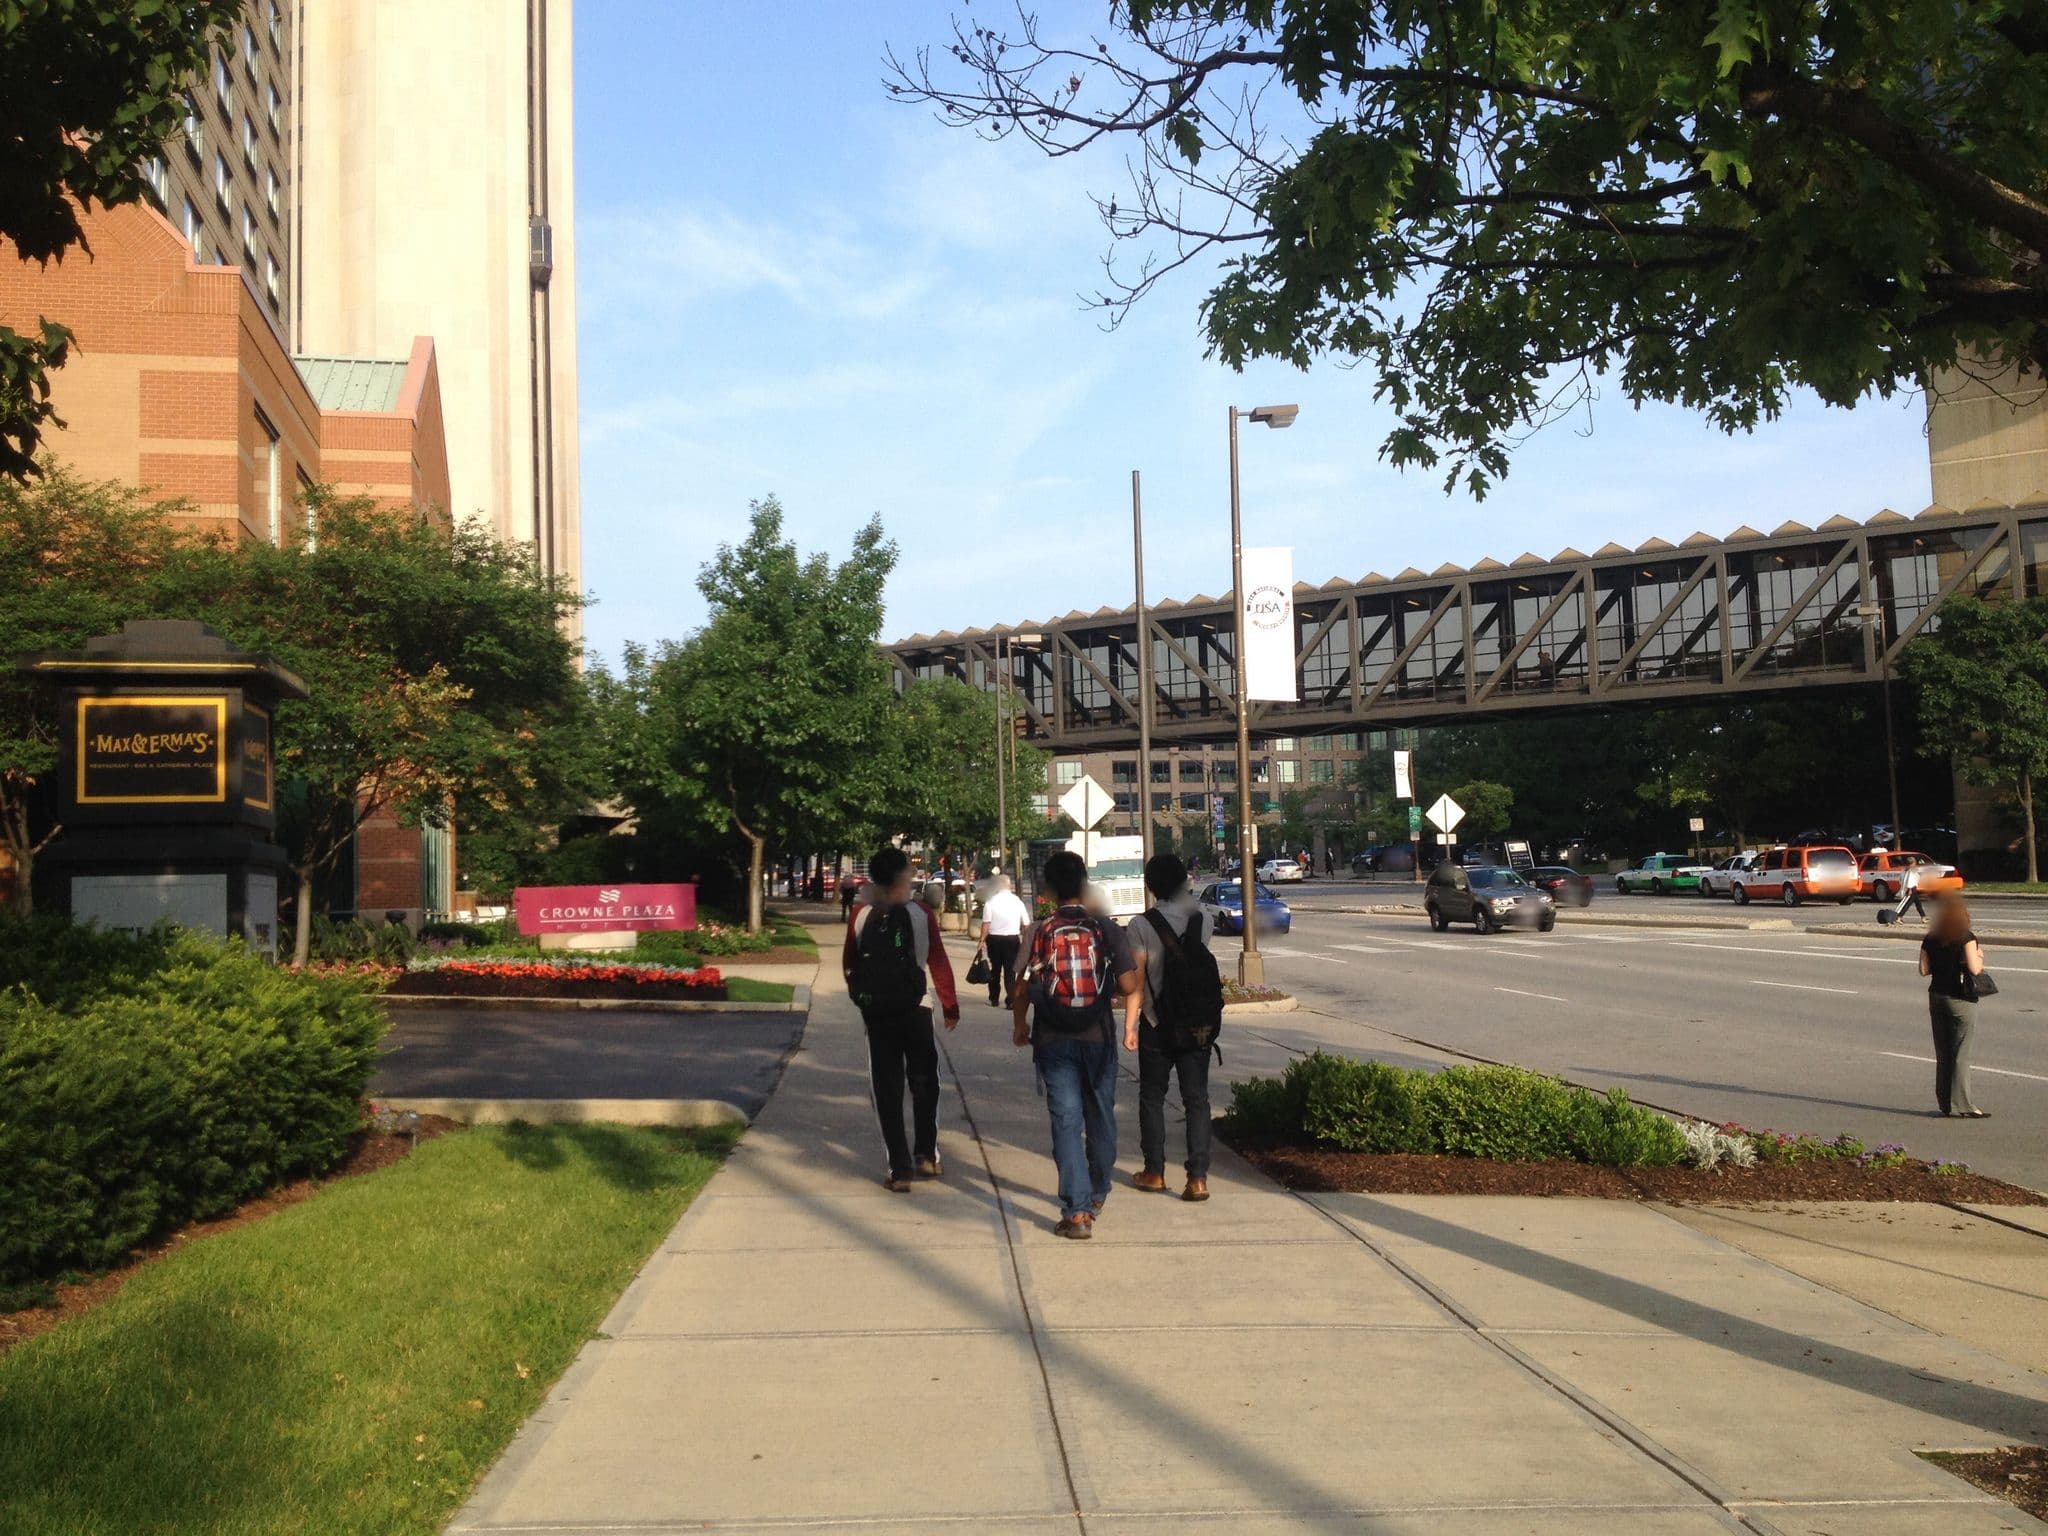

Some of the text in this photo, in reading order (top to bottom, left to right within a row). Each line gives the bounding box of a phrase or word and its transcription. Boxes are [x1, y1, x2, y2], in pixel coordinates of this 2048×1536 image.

[1255, 600, 1281, 614] USA
[539, 904, 675, 920] CROWNE PLAZA
